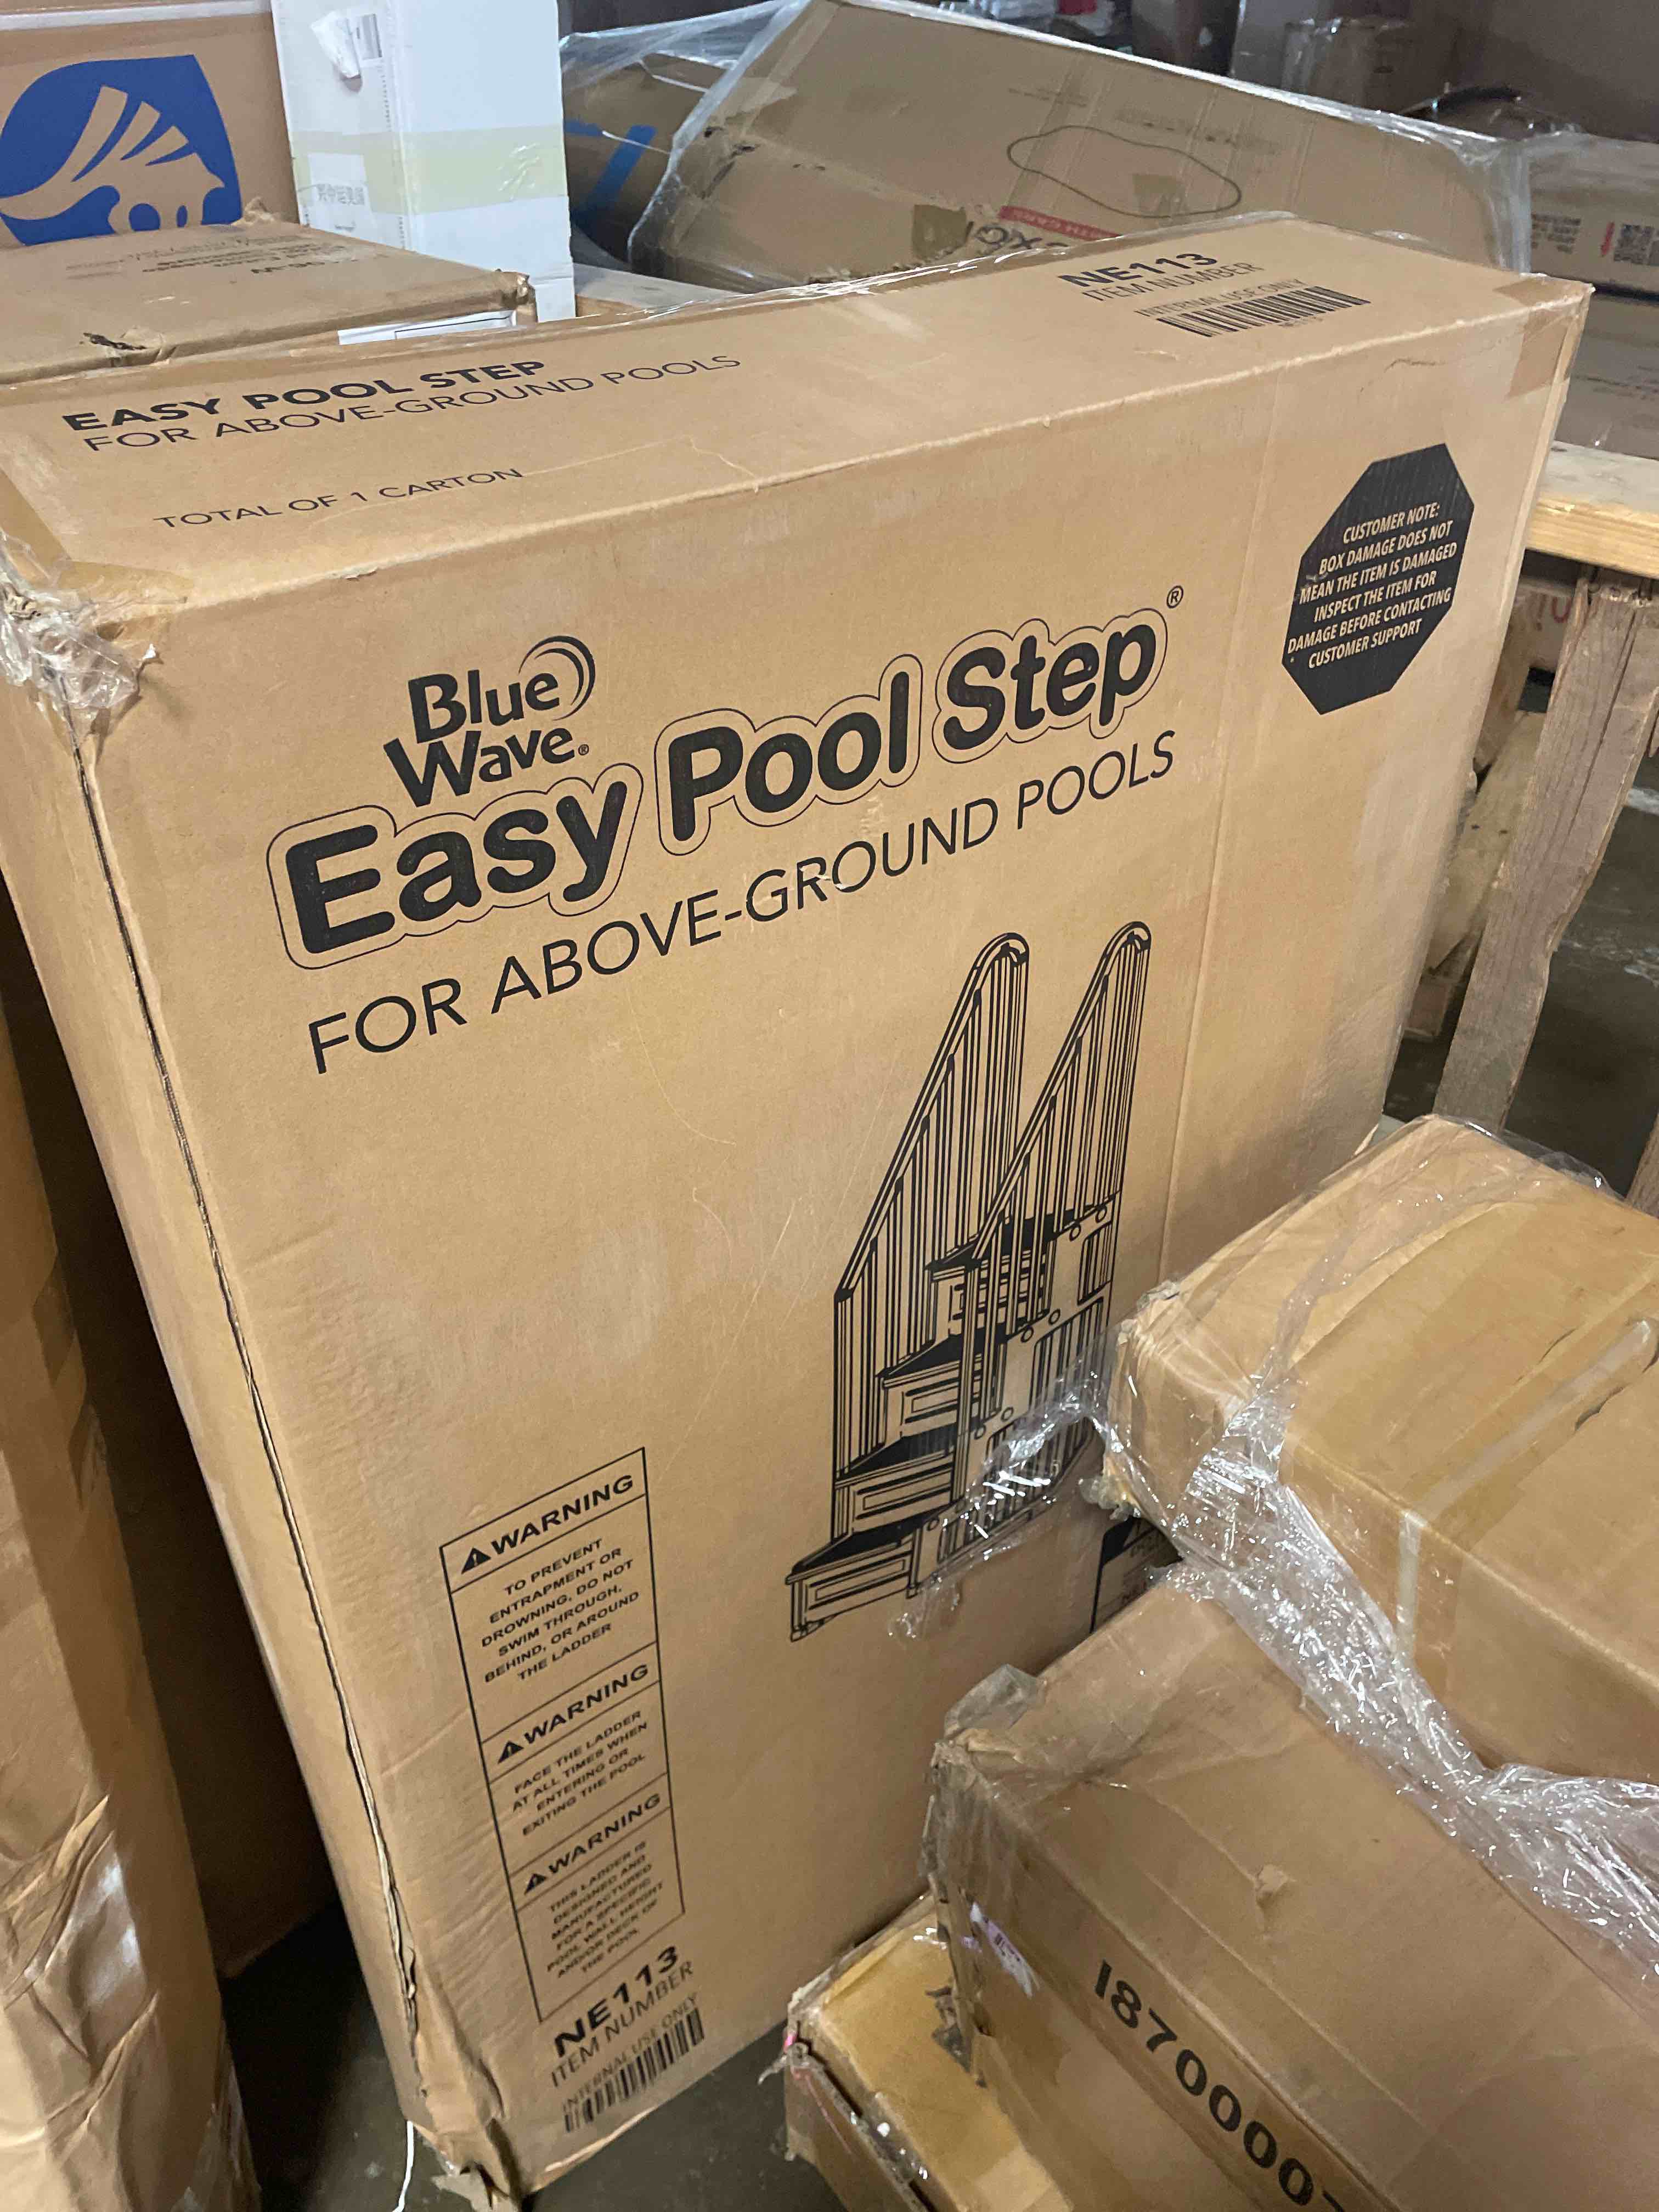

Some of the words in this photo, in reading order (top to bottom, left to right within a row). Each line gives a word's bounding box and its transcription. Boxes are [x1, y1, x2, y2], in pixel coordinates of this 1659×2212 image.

[1058, 253, 1217, 287] NE113
[1082, 282, 1153, 301] ITEM
[1147, 262, 1264, 290] NUMBER
[1134, 295, 1223, 317] INTERNAL
[1256, 278, 1308, 294] ONLY
[63, 398, 221, 431] EASY
[242, 380, 414, 409] POOL
[419, 360, 545, 388] STEP
[84, 428, 199, 451] FOR
[216, 377, 594, 437] ABOVE-GROUND
[601, 356, 741, 384] POOLS
[154, 506, 282, 527] TOTAL
[288, 495, 338, 511] OF
[351, 492, 369, 502] 1
[379, 468, 523, 497] CARTON
[1343, 512, 1404, 544] CUSTOMER
[1407, 503, 1440, 526] NOTE:
[1300, 582, 1334, 605] MEAN
[1337, 574, 1358, 592] THE
[1361, 564, 1387, 585] ITEM
[1389, 558, 1401, 576] IS
[1402, 543, 1458, 571] DAMAGED
[1319, 555, 1345, 575] BOX
[1347, 539, 1396, 567] DAMAGE
[1398, 530, 1427, 551] DOES
[1429, 521, 1453, 541] NOT
[1288, 624, 1338, 654] DAMAGE
[1340, 611, 1382, 637] BEFORE
[1384, 587, 1451, 622] CONTACTING
[1314, 595, 1362, 622] INSPECT
[1364, 588, 1384, 607] THE
[1385, 578, 1412, 600] ITEM
[1414, 571, 1437, 591] FOR
[1308, 637, 1369, 669] CUSTOMER
[1371, 619, 1422, 648] SUPPORT
[408, 669, 561, 744] Blue
[285, 781, 628, 953] Easy
[668, 672, 909, 841] Pool
[943, 624, 1155, 751] Step
[308, 977, 467, 1074] FOR
[491, 798, 997, 1014] ABOVE-GROUND
[1017, 730, 1175, 829] POOLS
[491, 1475, 633, 1555] WARNING
[489, 1562, 594, 1624] ENTRAPMENT
[600, 1548, 621, 1565] OR
[504, 1579, 526, 1595] TO
[531, 1538, 602, 1583] PREVENT
[577, 1578, 599, 1595] DO
[603, 1559, 634, 1582] NOT
[484, 1645, 546, 1683] BEHIND,
[551, 1627, 573, 1645] OR
[576, 1591, 639, 1632] AROUND
[499, 1628, 540, 1657] SWIM
[517, 1658, 548, 1680] THE
[552, 1623, 611, 1662] LADDER
[524, 1664, 648, 1744] WARNING
[513, 1796, 531, 1813] AT
[533, 1778, 559, 1798] ALL
[562, 1748, 604, 1779] TIMES
[607, 1722, 647, 1750] WHEN
[514, 1767, 551, 1793] FACE
[554, 1747, 582, 1767] THE
[586, 1711, 641, 1750] LADDER
[537, 1764, 605, 1811] ENTERING
[608, 1748, 629, 1764] OR
[522, 1796, 577, 1837] EXITING
[579, 1778, 607, 1798] THE
[609, 1754, 646, 1780] POOL
[549, 1793, 661, 1874] WARNING
[551, 2036, 600, 2087] ITEM
[605, 1961, 693, 2042] NUMBER
[554, 1946, 678, 2057] NE113
